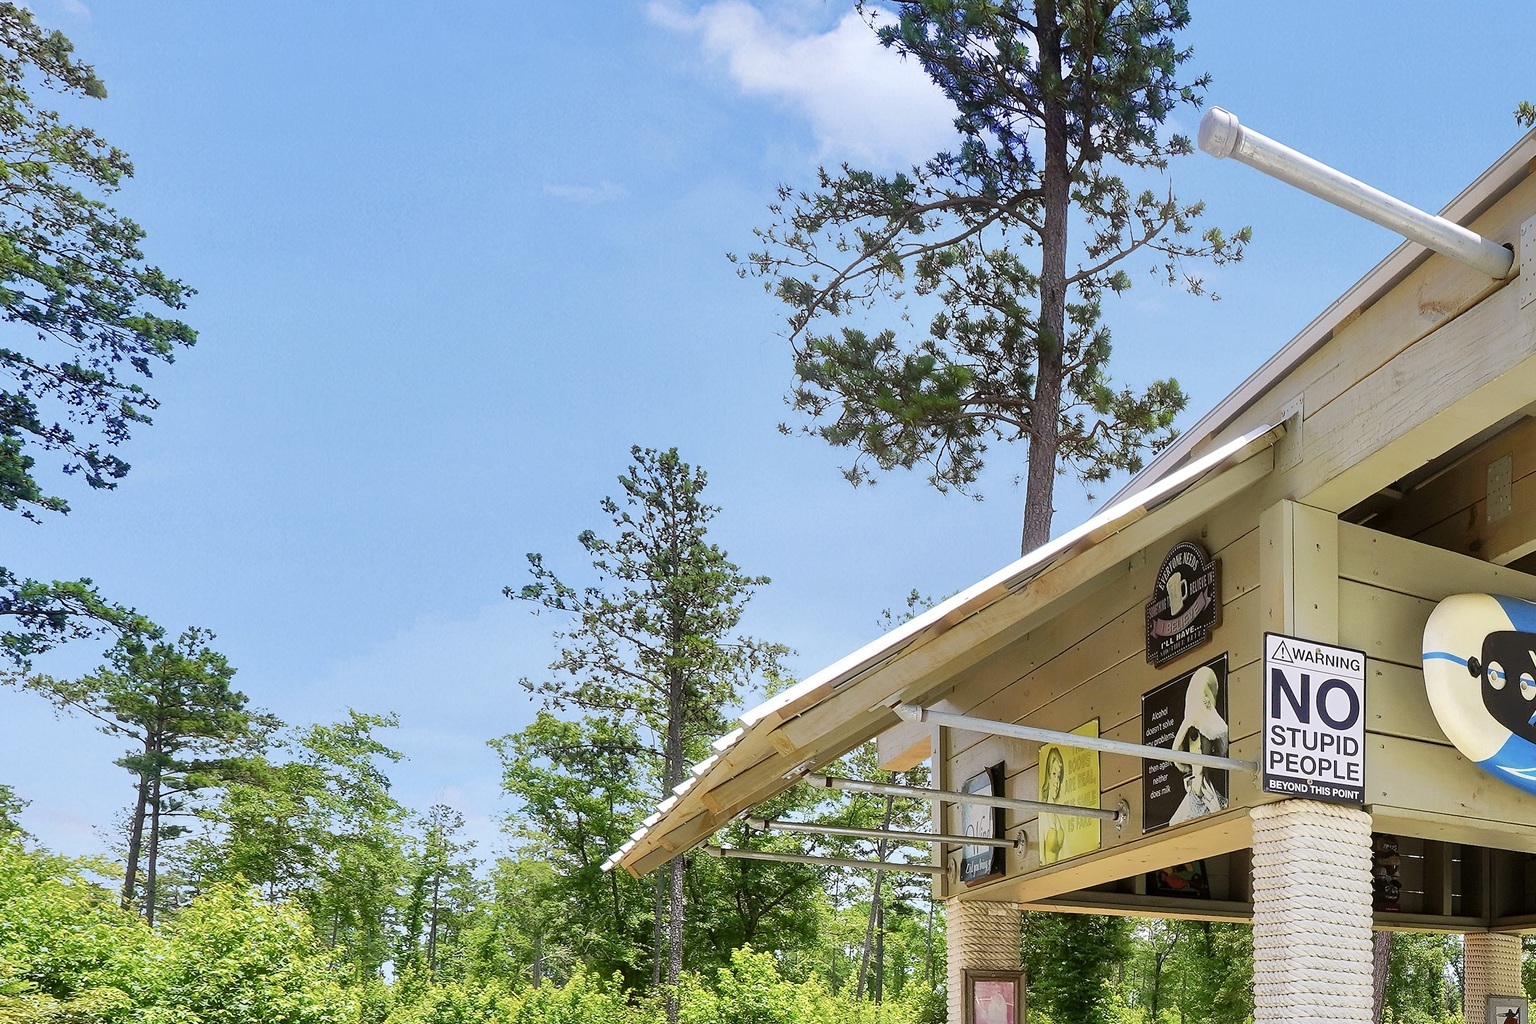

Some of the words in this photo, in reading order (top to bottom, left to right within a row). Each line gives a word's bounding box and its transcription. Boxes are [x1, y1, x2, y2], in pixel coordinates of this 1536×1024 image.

[1160, 637, 1174, 650] I'LL
[1292, 647, 1360, 672] WARNING
[1271, 667, 1360, 731] NO
[1151, 706, 1169, 721] Alcohol
[1162, 717, 1175, 730] solve
[1270, 724, 1359, 757] STUPID
[1270, 750, 1360, 782] PEOPLE
[1152, 773, 1169, 786] neither
[1150, 789, 1161, 800] does
[1161, 784, 1172, 796] milk
[1269, 779, 1308, 793] BEYOND
[1310, 785, 1331, 796] THIS
[1332, 788, 1359, 800] POINT
